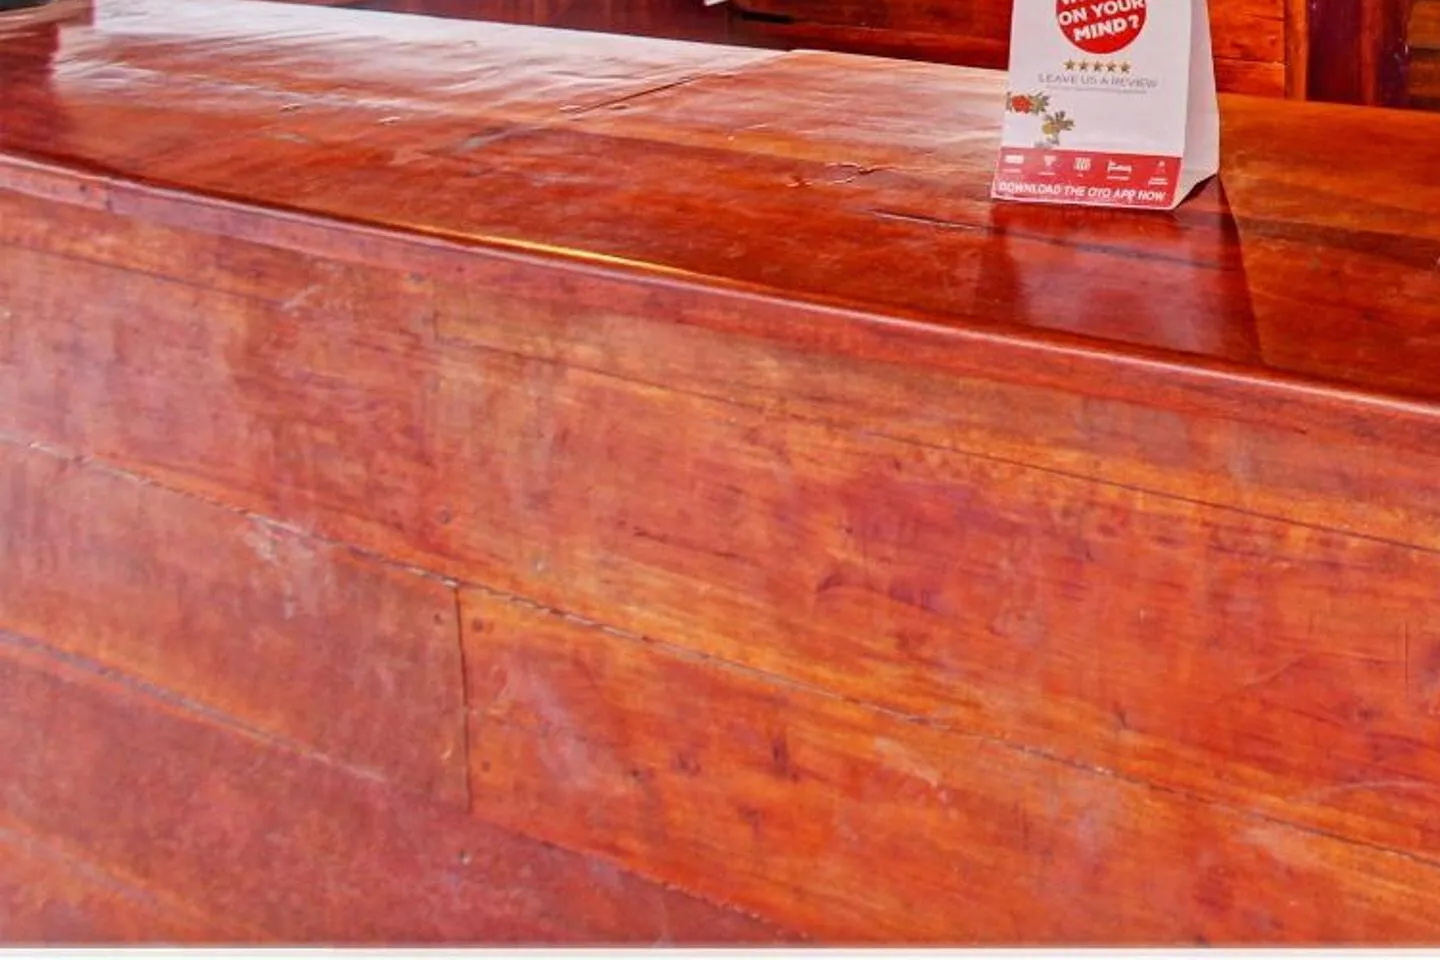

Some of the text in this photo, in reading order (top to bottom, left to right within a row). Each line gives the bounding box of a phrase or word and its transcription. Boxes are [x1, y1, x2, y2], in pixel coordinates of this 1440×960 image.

[1059, 7, 1087, 26] ON
[1073, 15, 1140, 42] MIND?
[1038, 73, 1075, 85] LEAVE
[1081, 74, 1097, 85] US
[999, 181, 1063, 196] DOWNLOAD
[1064, 185, 1086, 197] THE
[1114, 188, 1136, 201] APP
[1138, 189, 1167, 201] NOW
